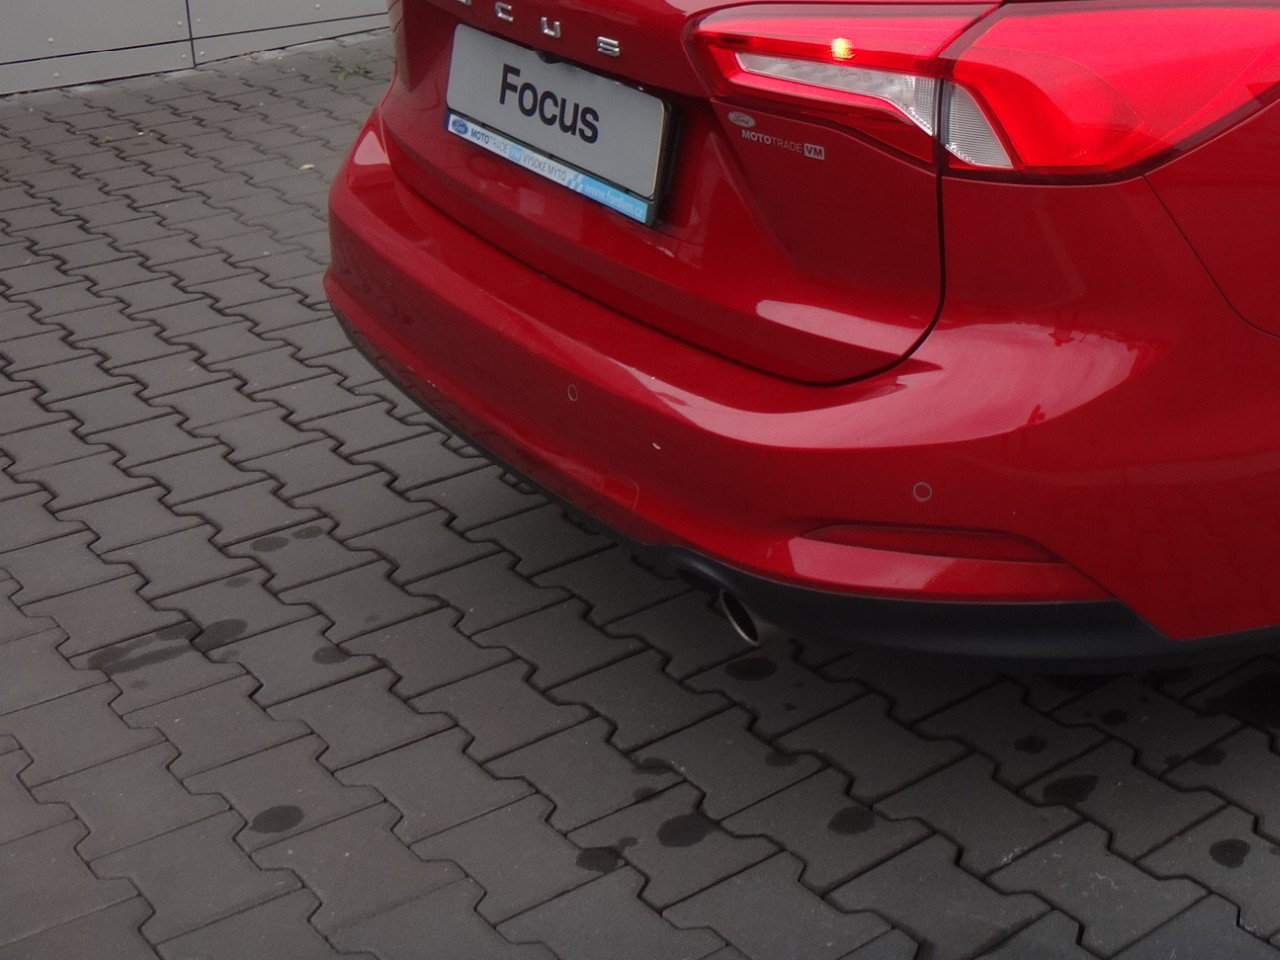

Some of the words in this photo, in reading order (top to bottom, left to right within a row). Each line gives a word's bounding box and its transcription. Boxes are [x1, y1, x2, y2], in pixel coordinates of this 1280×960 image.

[499, 63, 600, 144] Focus
[741, 129, 802, 153] MOTOTRADE
[805, 145, 823, 158] VM
